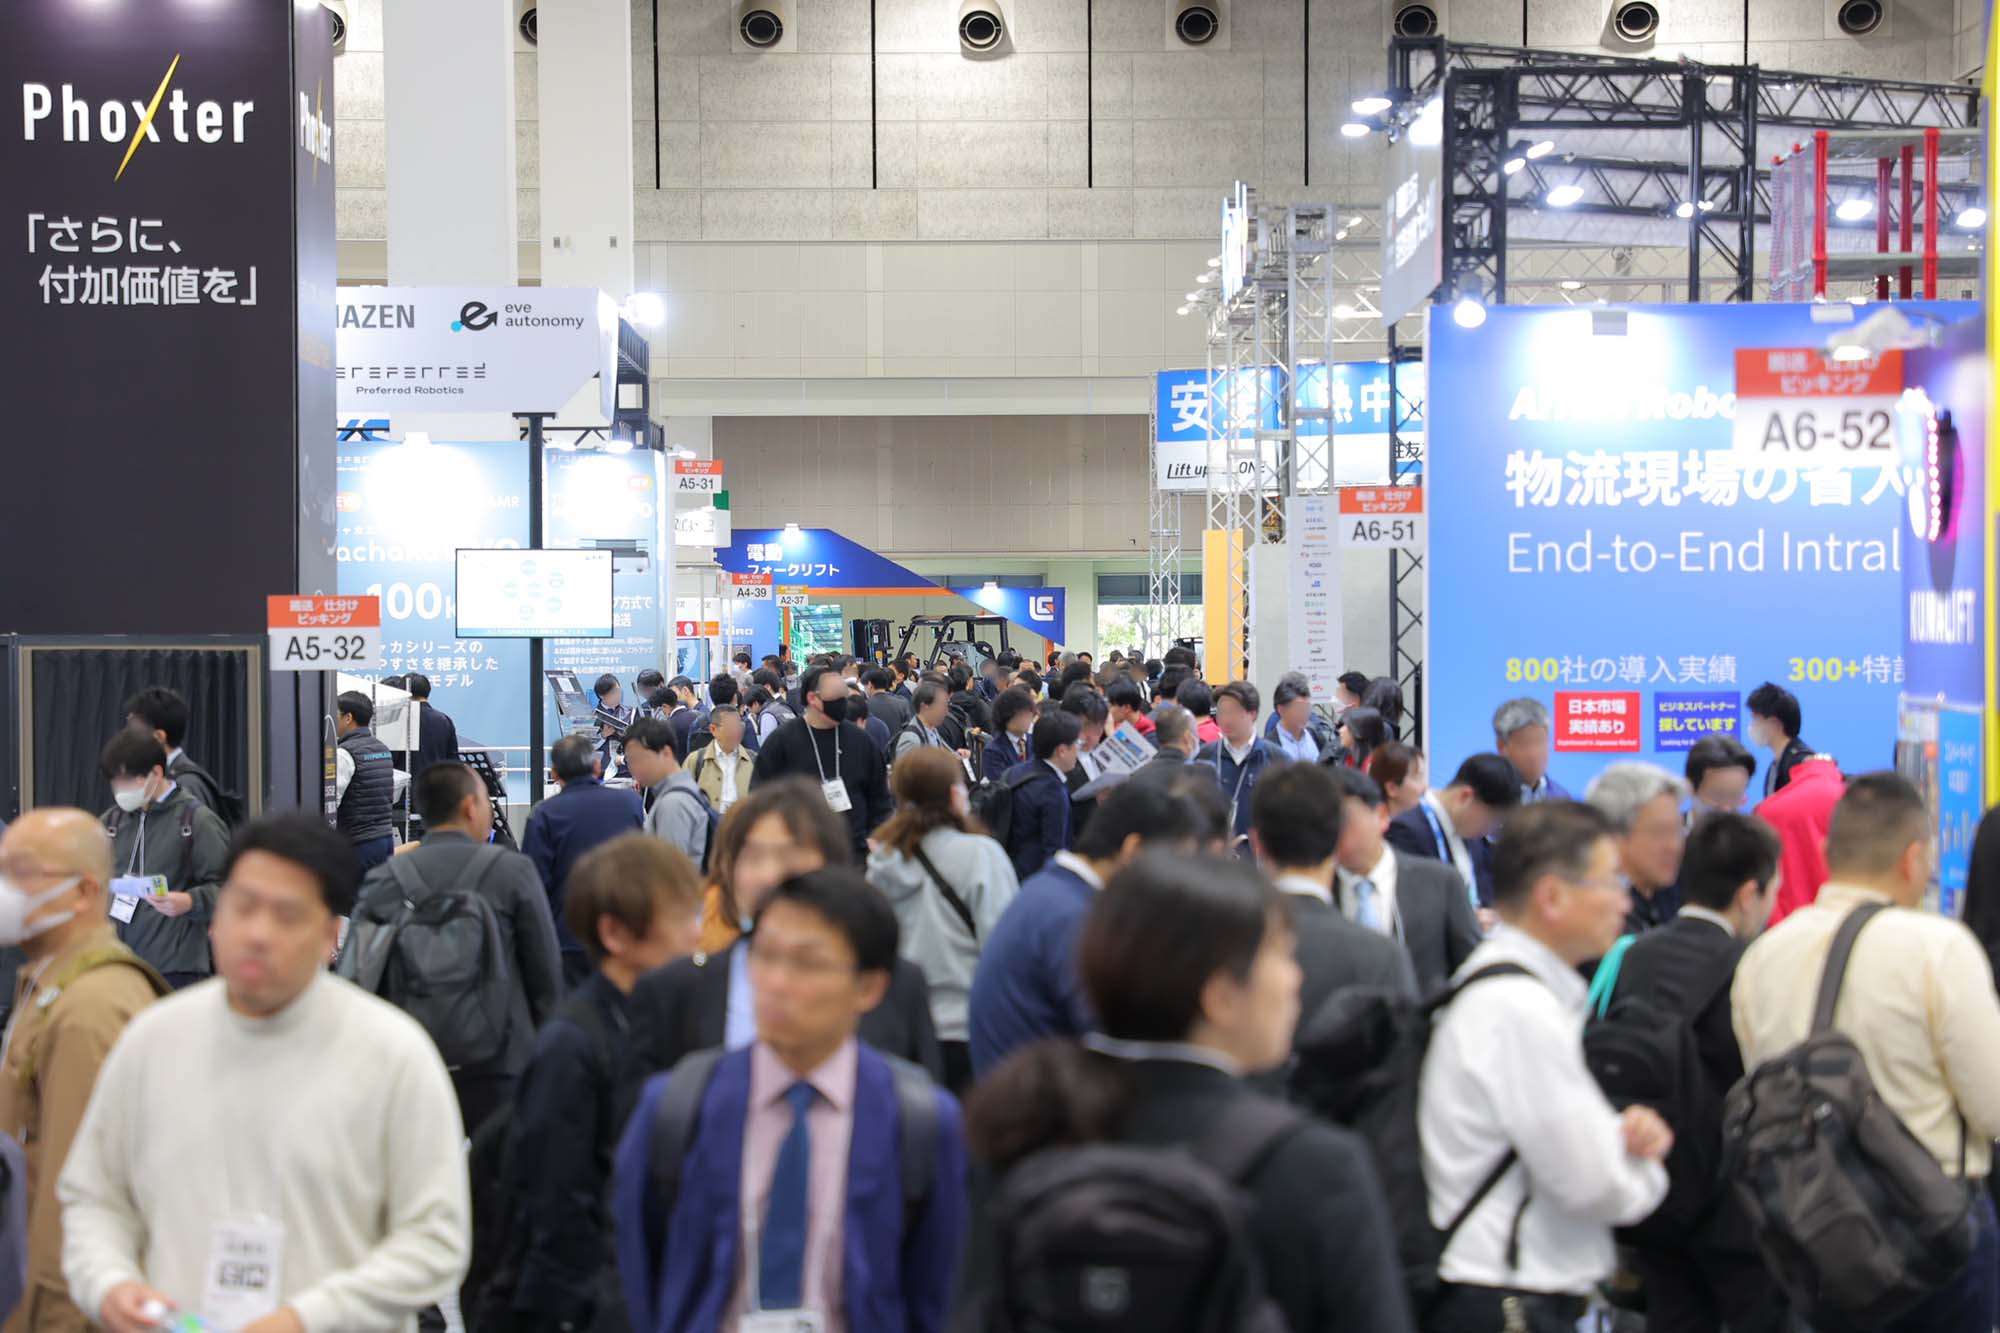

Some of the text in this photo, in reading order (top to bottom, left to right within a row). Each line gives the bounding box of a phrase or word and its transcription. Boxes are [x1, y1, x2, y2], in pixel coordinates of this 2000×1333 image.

[22, 82, 254, 144] Phoxter
[28, 213, 182, 253] 「さらに、
[39, 264, 257, 305] 付加価値を」
[505, 303, 532, 313] eve
[505, 315, 584, 329] autonomy
[356, 386, 465, 395] Preferred Robotics
[1761, 410, 1891, 451] A6-52
[679, 477, 714, 490] A5-31
[1351, 520, 1415, 541] A6-51
[1507, 528, 1900, 573] End-to-End Intral
[747, 563, 840, 577] フォークリフト
[736, 587, 767, 598] A4-39
[780, 595, 805, 605] A2-37
[284, 634, 366, 661] A5-32
[1506, 655, 1737, 685] 800社の導入実績
[1568, 699, 1627, 714] 日本市場
[1568, 719, 1626, 735] 実績あり
